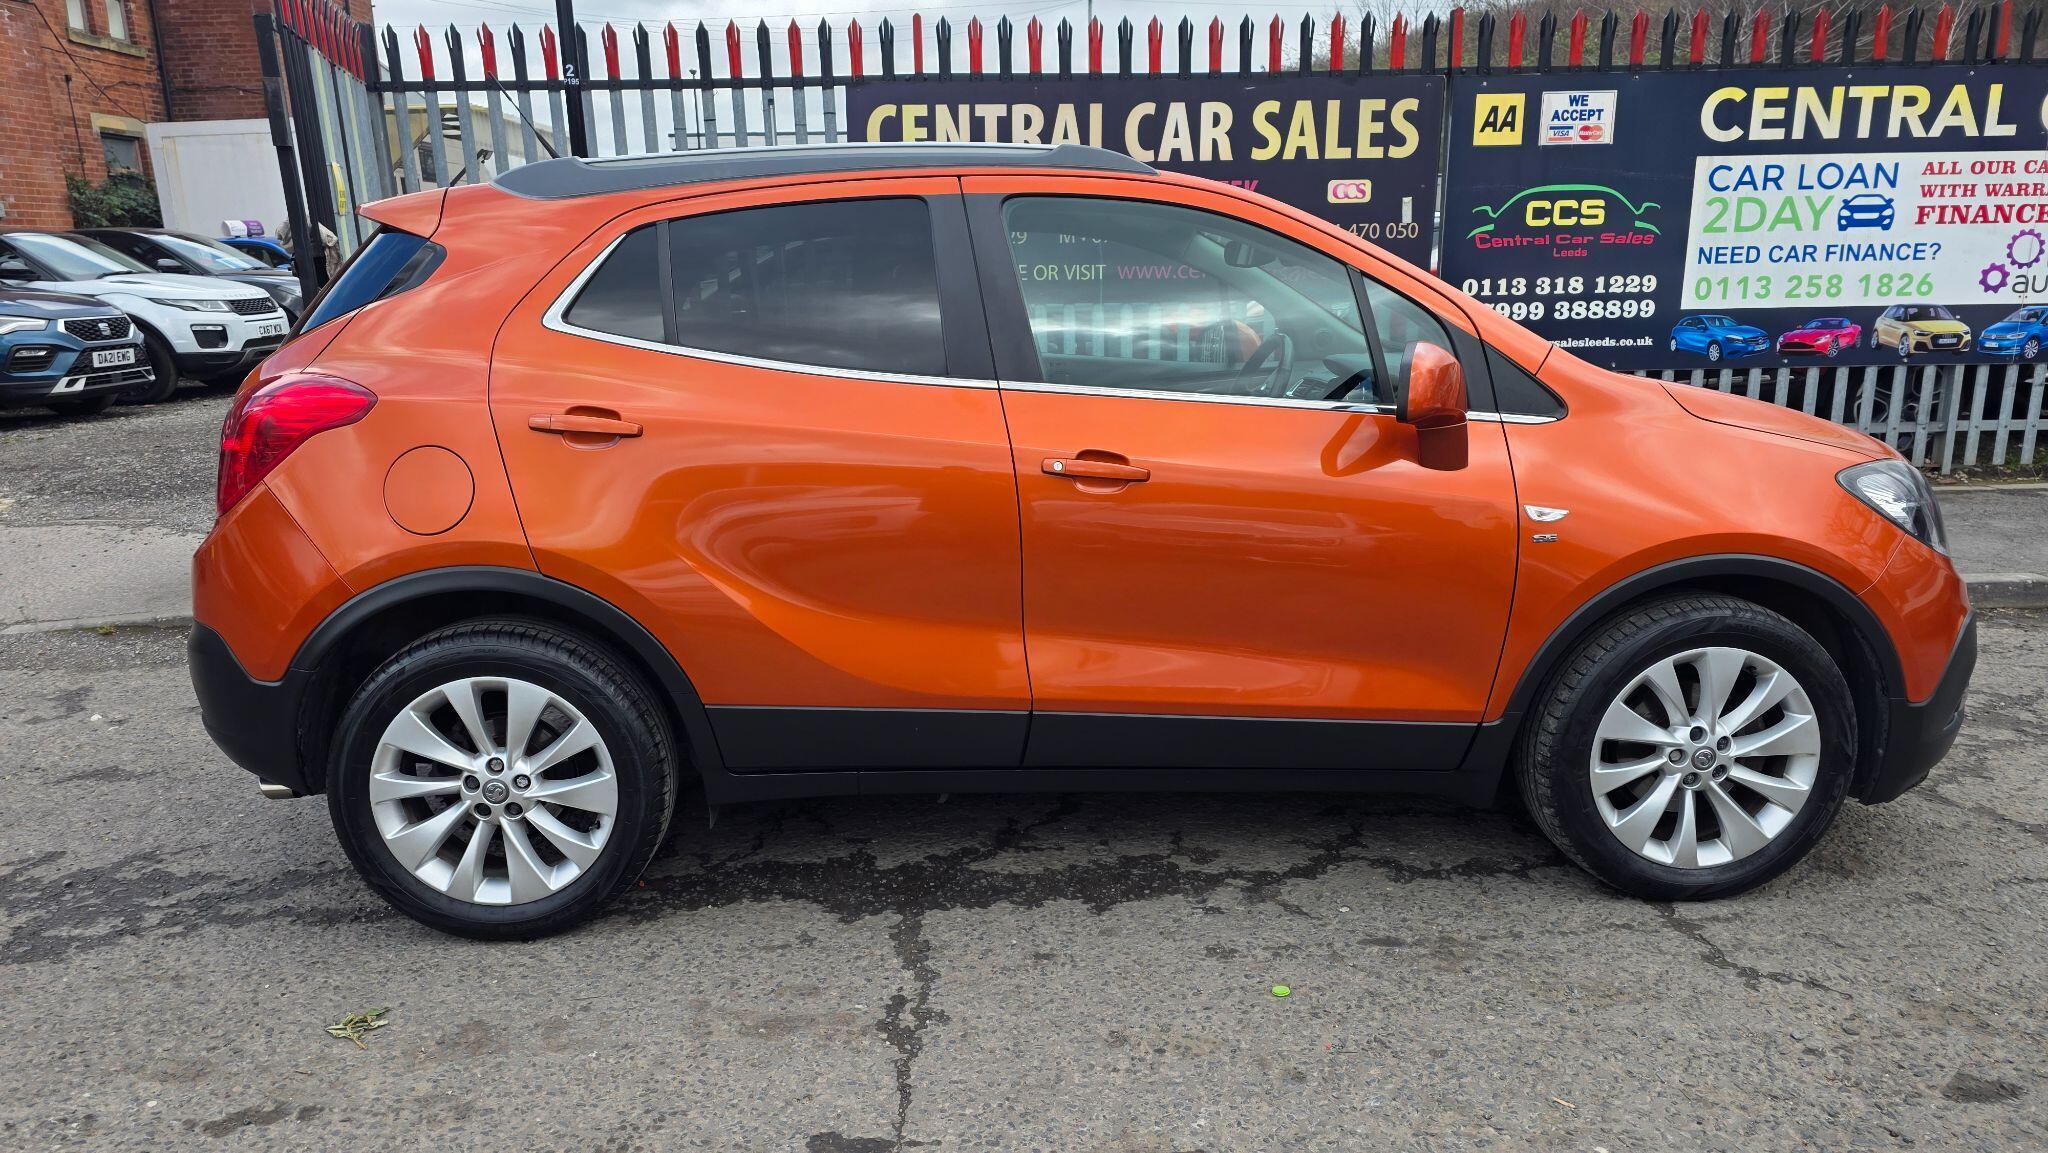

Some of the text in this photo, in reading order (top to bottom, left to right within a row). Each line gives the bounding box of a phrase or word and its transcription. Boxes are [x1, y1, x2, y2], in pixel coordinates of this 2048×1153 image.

[565, 64, 575, 77] 2
[1569, 95, 1589, 107] WE
[1479, 105, 1517, 133] AA
[1551, 109, 1604, 122] ACCEPT
[1700, 83, 2017, 142] CENTRAL
[866, 98, 1420, 163] CENTRAL CAR SALES
[1708, 162, 1899, 192] CAR LOAN
[1922, 161, 1962, 175] ALL
[1970, 160, 2016, 175] OUR
[1333, 183, 1367, 199] CCS
[1920, 182, 2048, 198] WITH WARR
[1525, 199, 1606, 227] CCS
[1703, 195, 1834, 233] 2DAY
[1914, 203, 2048, 225] FINANCE
[1386, 222, 1419, 239] 050
[1475, 232, 1655, 249] Central Car Sales
[1553, 248, 1588, 257] Leeds
[1697, 242, 1942, 264] NEED CAR FINANCE?
[1034, 265, 1058, 280] OR
[1064, 265, 1107, 280] VISIT
[1462, 274, 1657, 296] 0113 318 1229
[1694, 272, 1934, 300] 0113 258 1826
[1485, 299, 1656, 321] 999 388899
[97, 352, 115, 364] DA21
